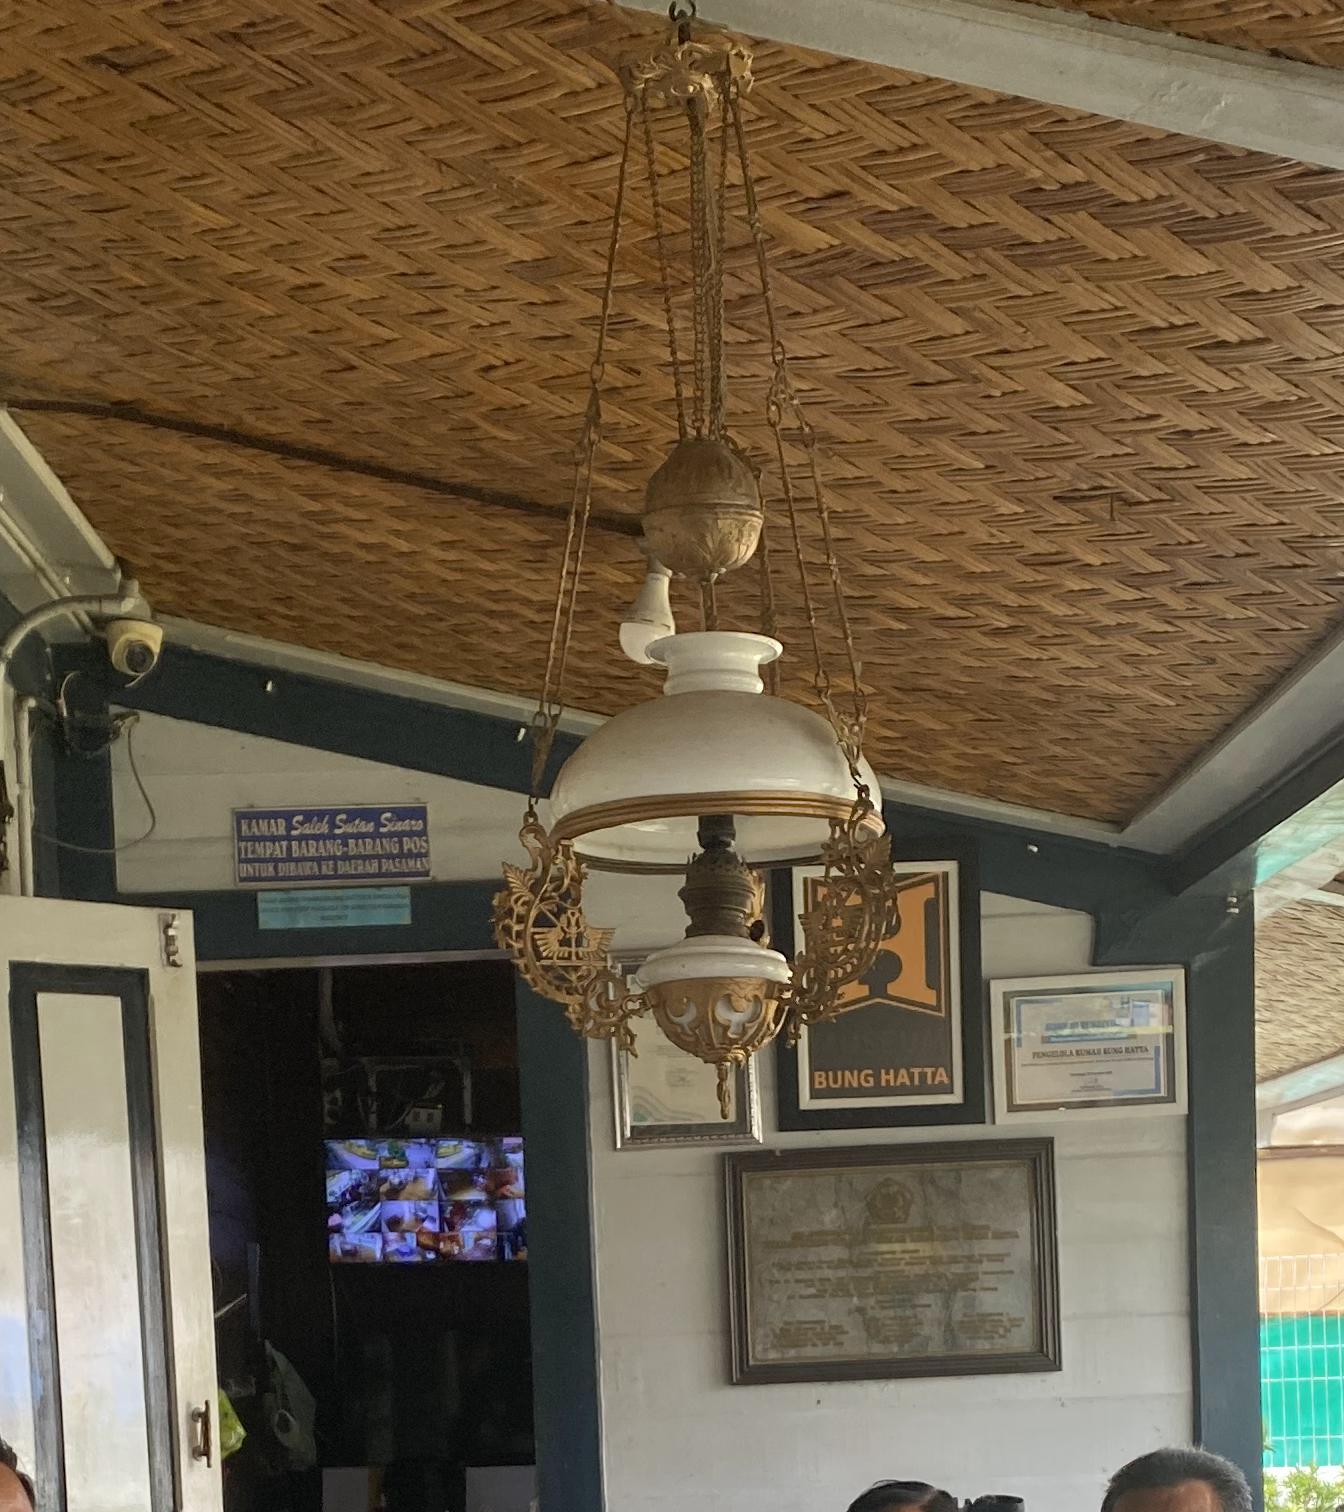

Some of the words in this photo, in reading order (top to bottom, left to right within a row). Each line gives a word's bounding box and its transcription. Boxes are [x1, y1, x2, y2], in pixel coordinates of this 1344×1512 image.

[241, 819, 286, 836] KAMAR
[334, 812, 375, 834] Sutan
[239, 841, 288, 858] TEMPAT
[291, 838, 399, 857] BARANG-BARANG
[403, 836, 428, 853] POS
[239, 862, 275, 877] UNTUK
[278, 861, 319, 876] DIBAWA
[321, 861, 335, 874] KE
[338, 859, 379, 874] DAERAH
[813, 1069, 874, 1089] BUNG
[880, 1066, 949, 1087] HATTA
